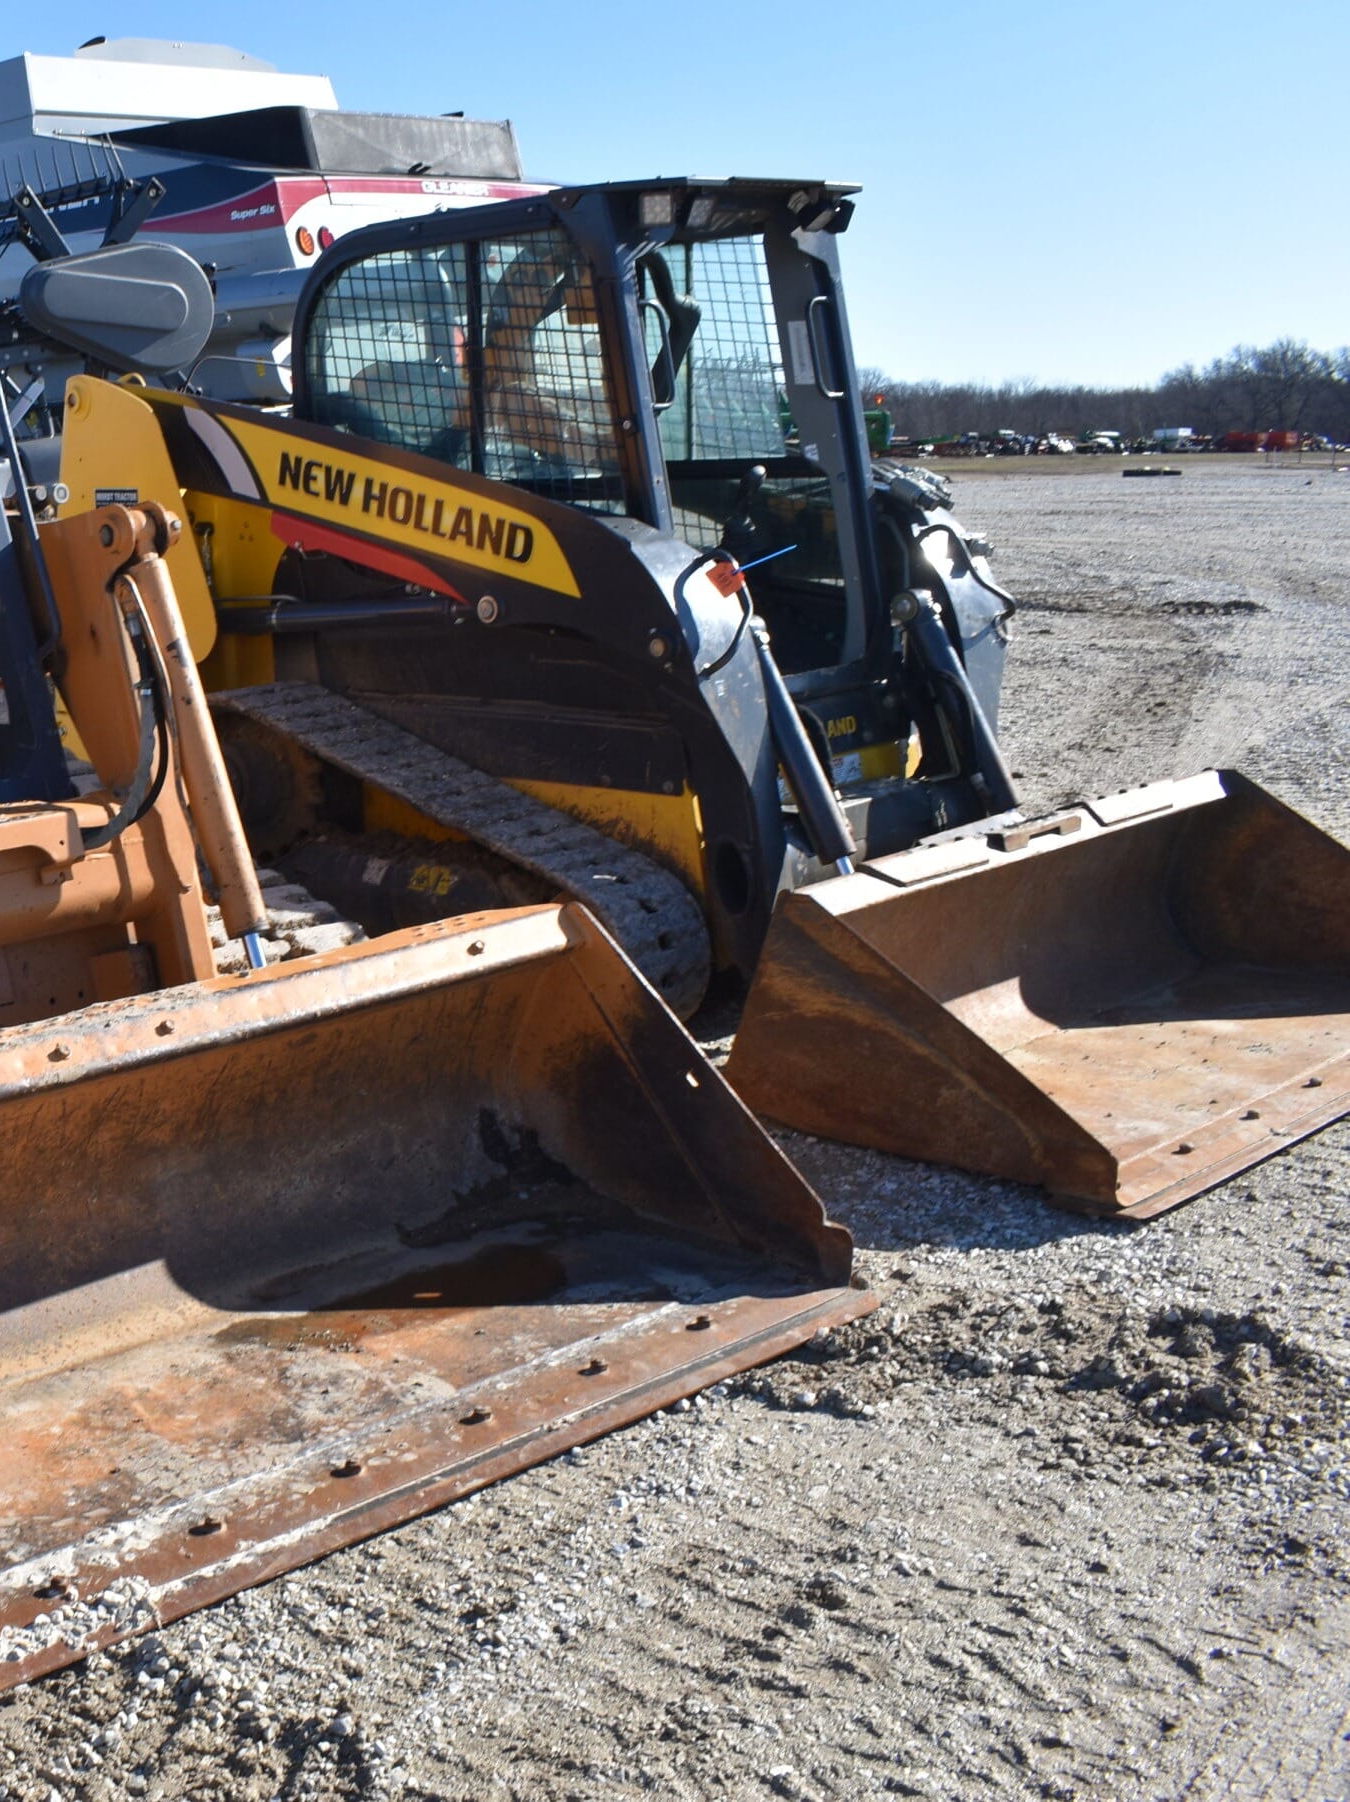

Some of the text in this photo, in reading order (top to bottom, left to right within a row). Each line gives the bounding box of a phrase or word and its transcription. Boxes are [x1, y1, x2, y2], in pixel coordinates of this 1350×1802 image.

[421, 181, 488, 196] GLEANER
[230, 204, 276, 221] Super Six
[278, 451, 534, 564] NEW HOLLAND
